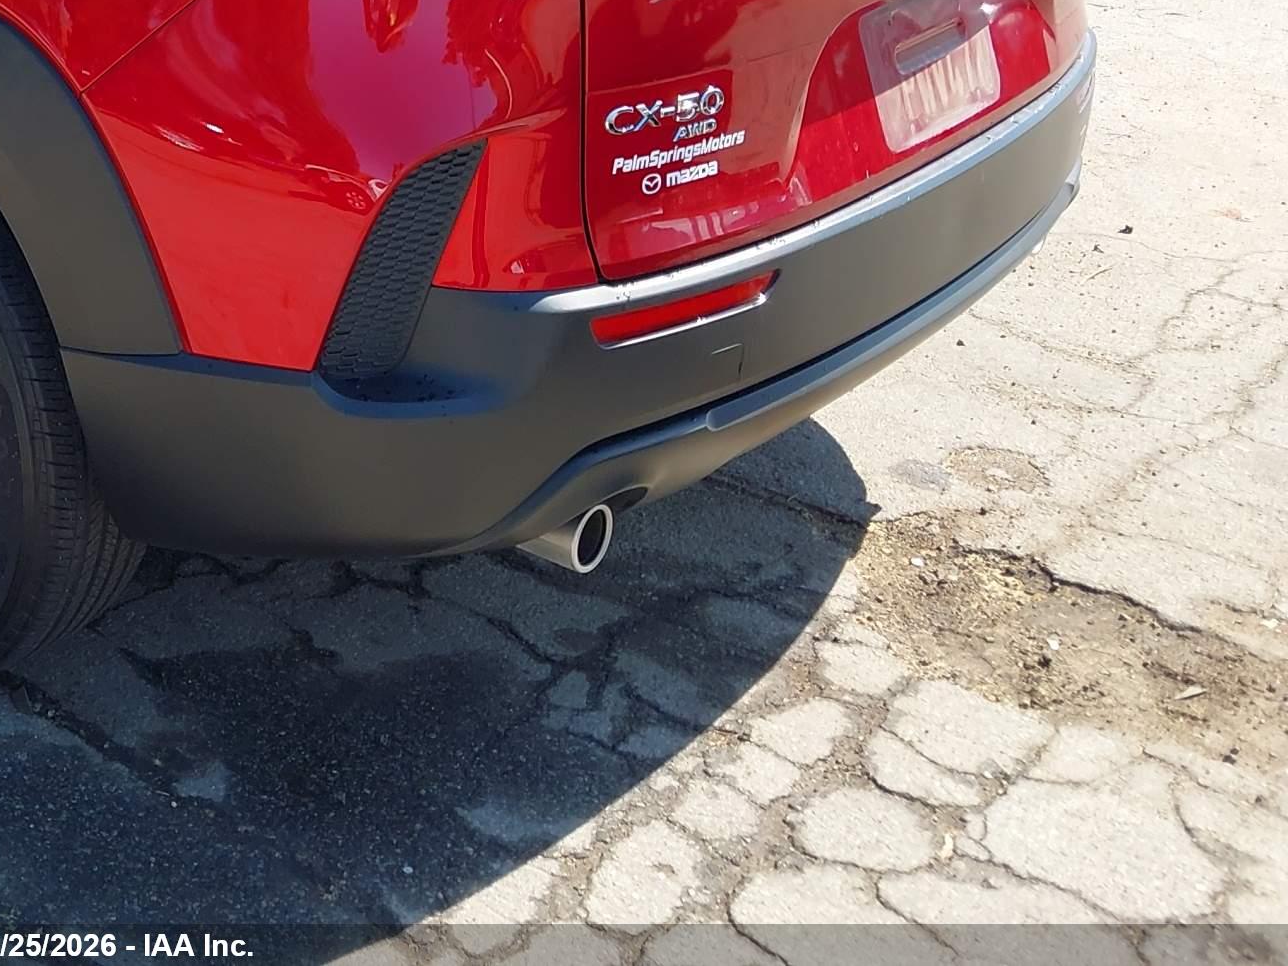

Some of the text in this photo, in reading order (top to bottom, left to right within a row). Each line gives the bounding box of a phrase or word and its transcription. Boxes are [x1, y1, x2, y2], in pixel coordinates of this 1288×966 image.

[605, 85, 725, 135] CX-50
[673, 118, 717, 142] AWD
[612, 130, 746, 175] PalmSpringsMotors
